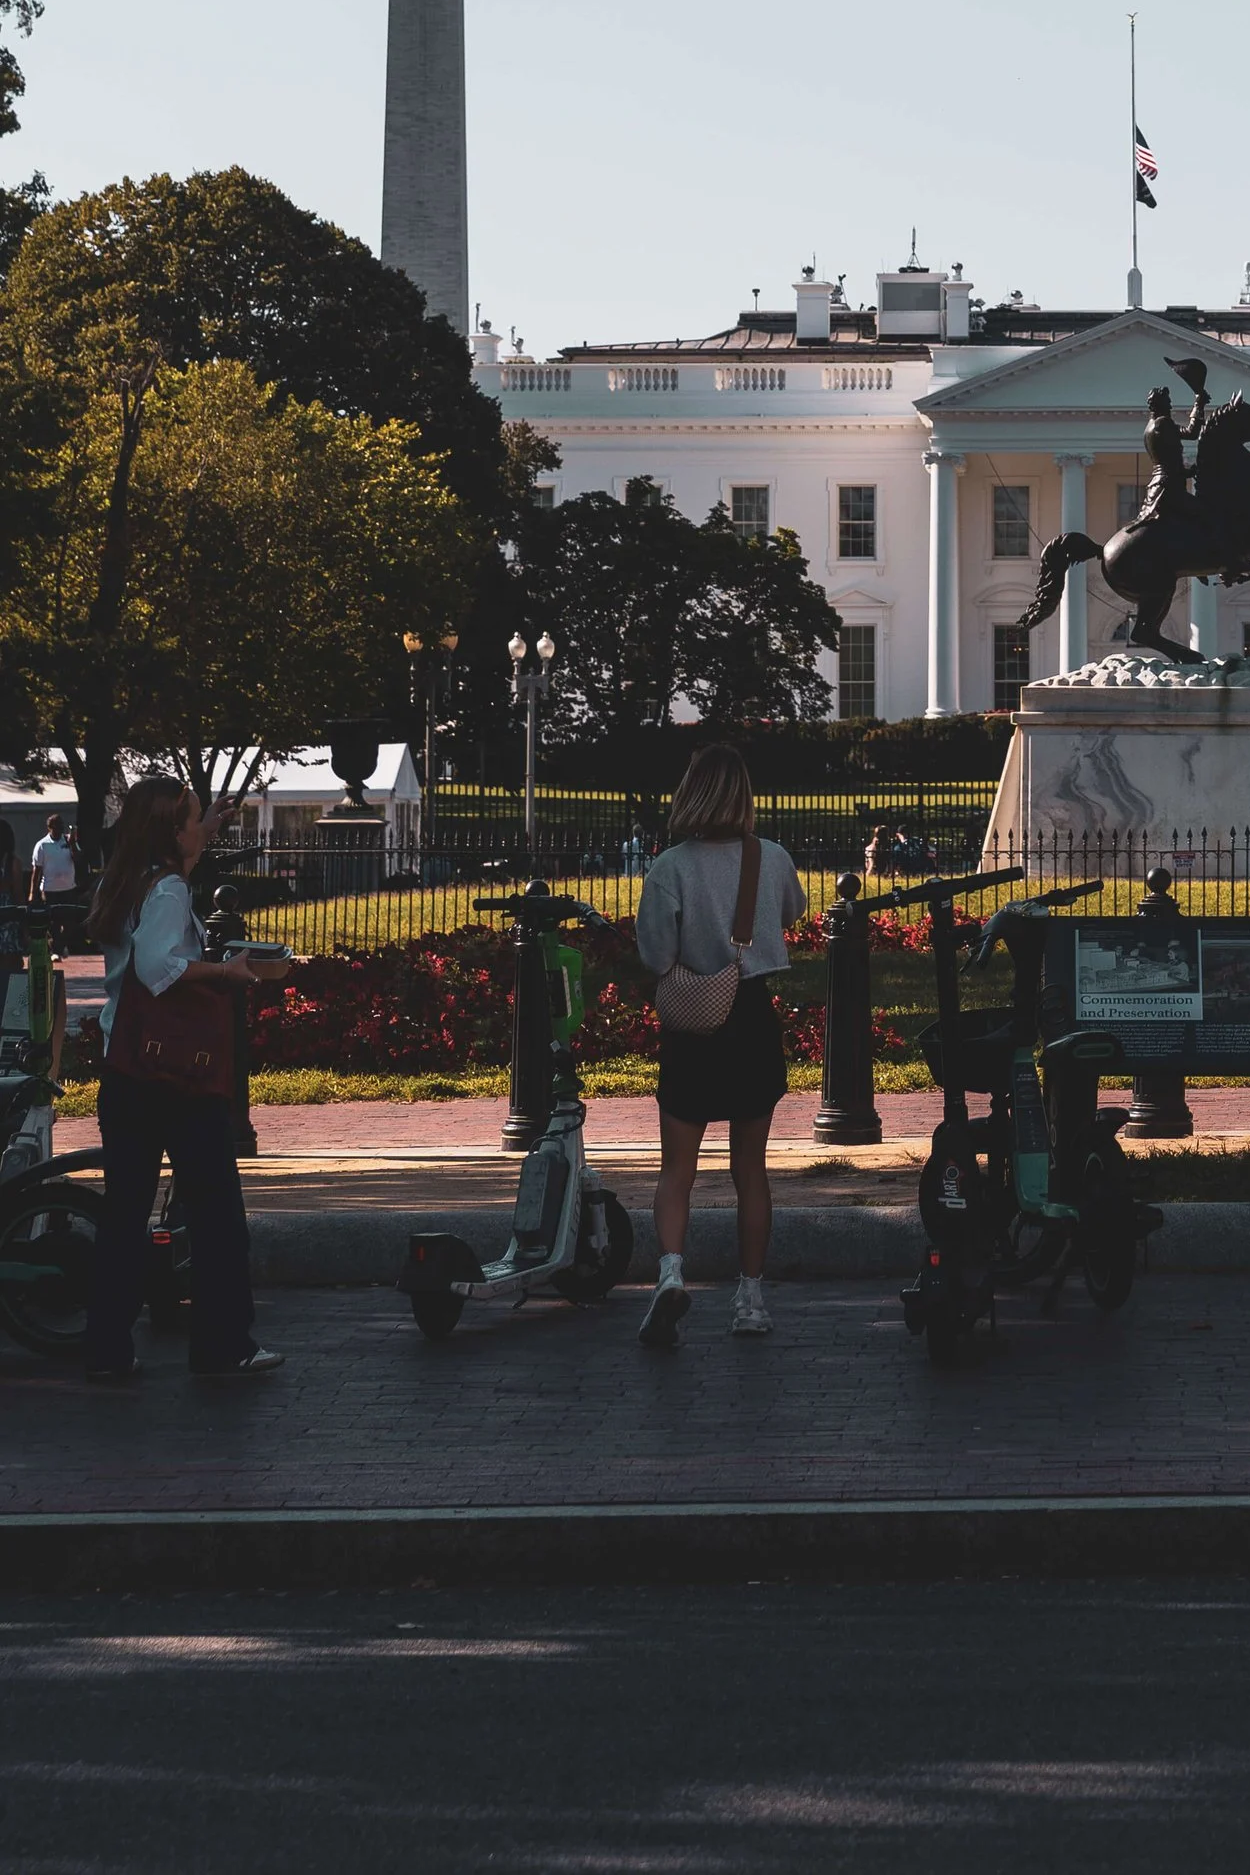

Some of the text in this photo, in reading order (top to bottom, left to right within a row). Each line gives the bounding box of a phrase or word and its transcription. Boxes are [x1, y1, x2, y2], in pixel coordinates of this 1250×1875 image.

[1080, 995, 1193, 1005] Commemoration
[1080, 1008, 1191, 1018] and Preservation
